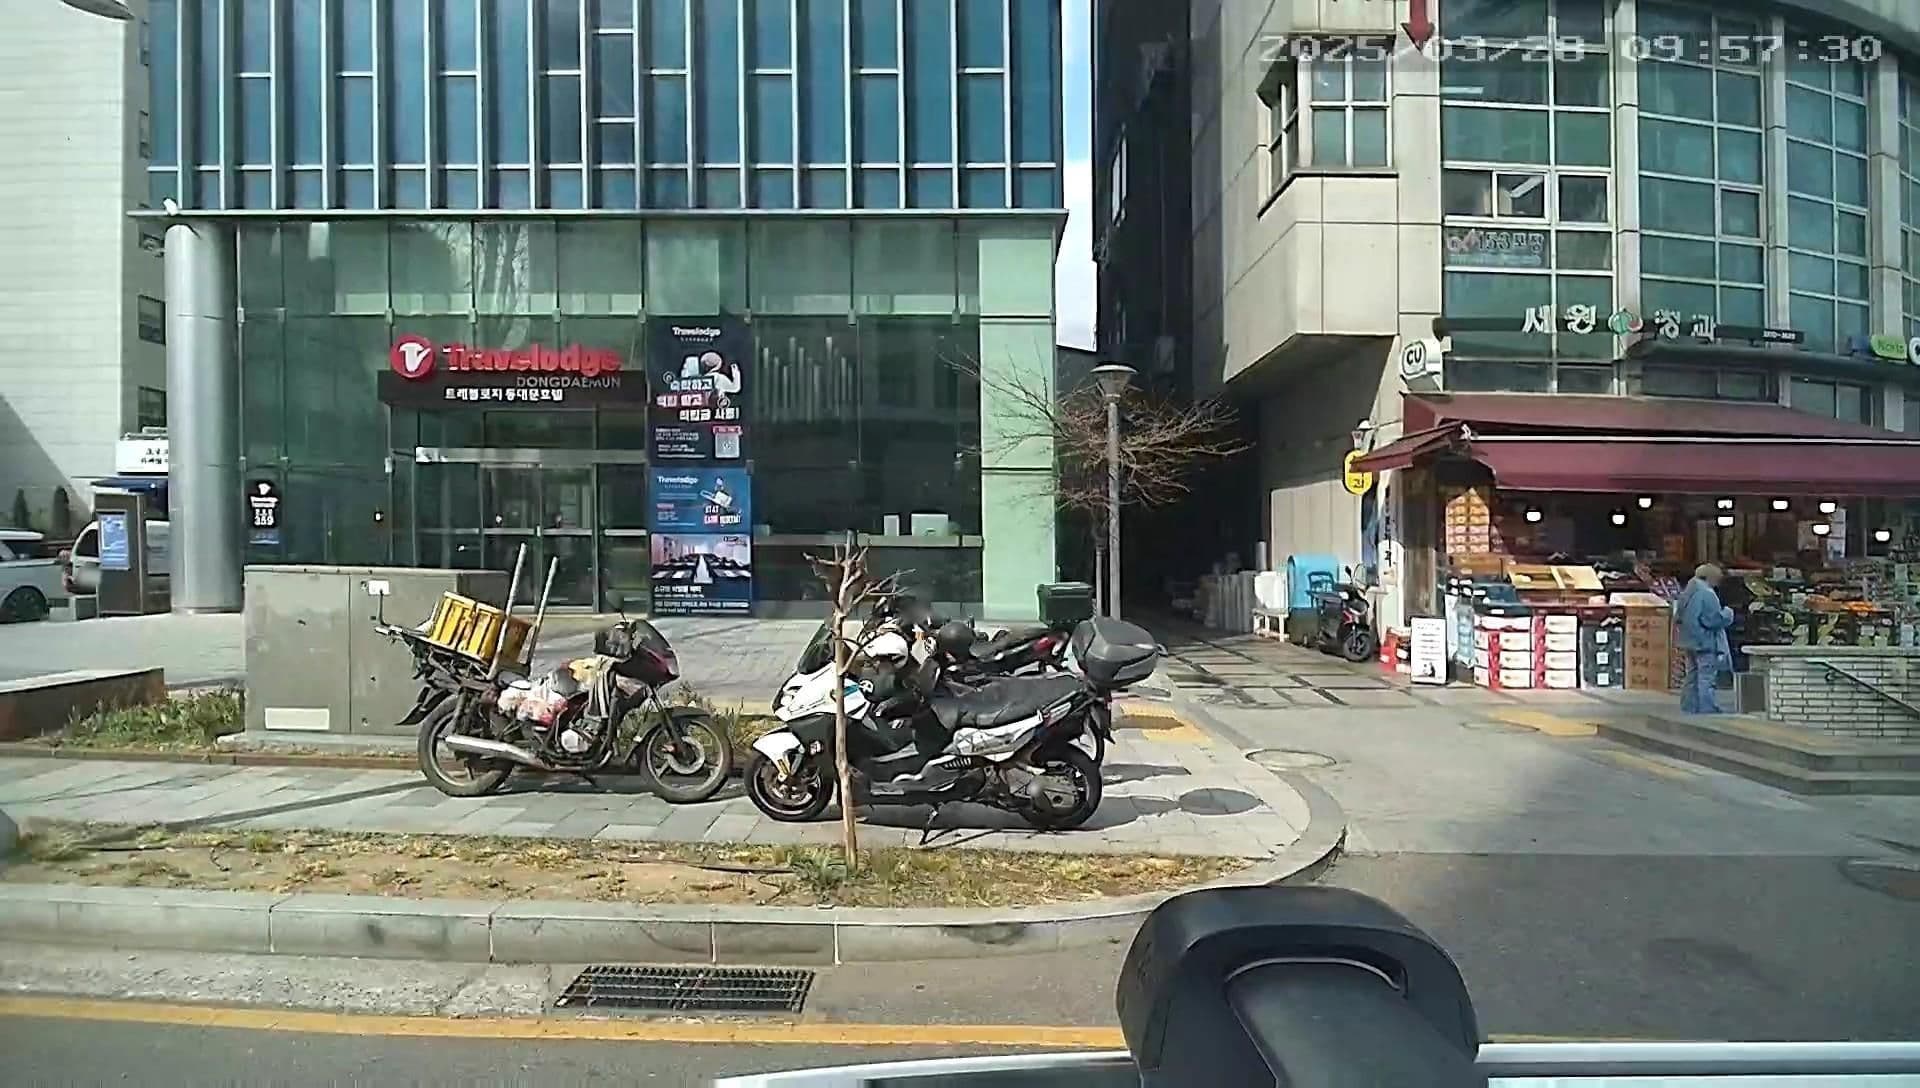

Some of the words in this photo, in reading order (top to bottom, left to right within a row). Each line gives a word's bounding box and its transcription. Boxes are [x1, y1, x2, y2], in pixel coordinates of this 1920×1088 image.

[1522, 303, 1597, 334] 세원
[1653, 309, 1717, 343] 청과
[443, 342, 624, 377] Travelodge
[1406, 346, 1423, 365] CU
[516, 376, 622, 388] DONGDAEMUN
[505, 387, 563, 400] 동대문호텔
